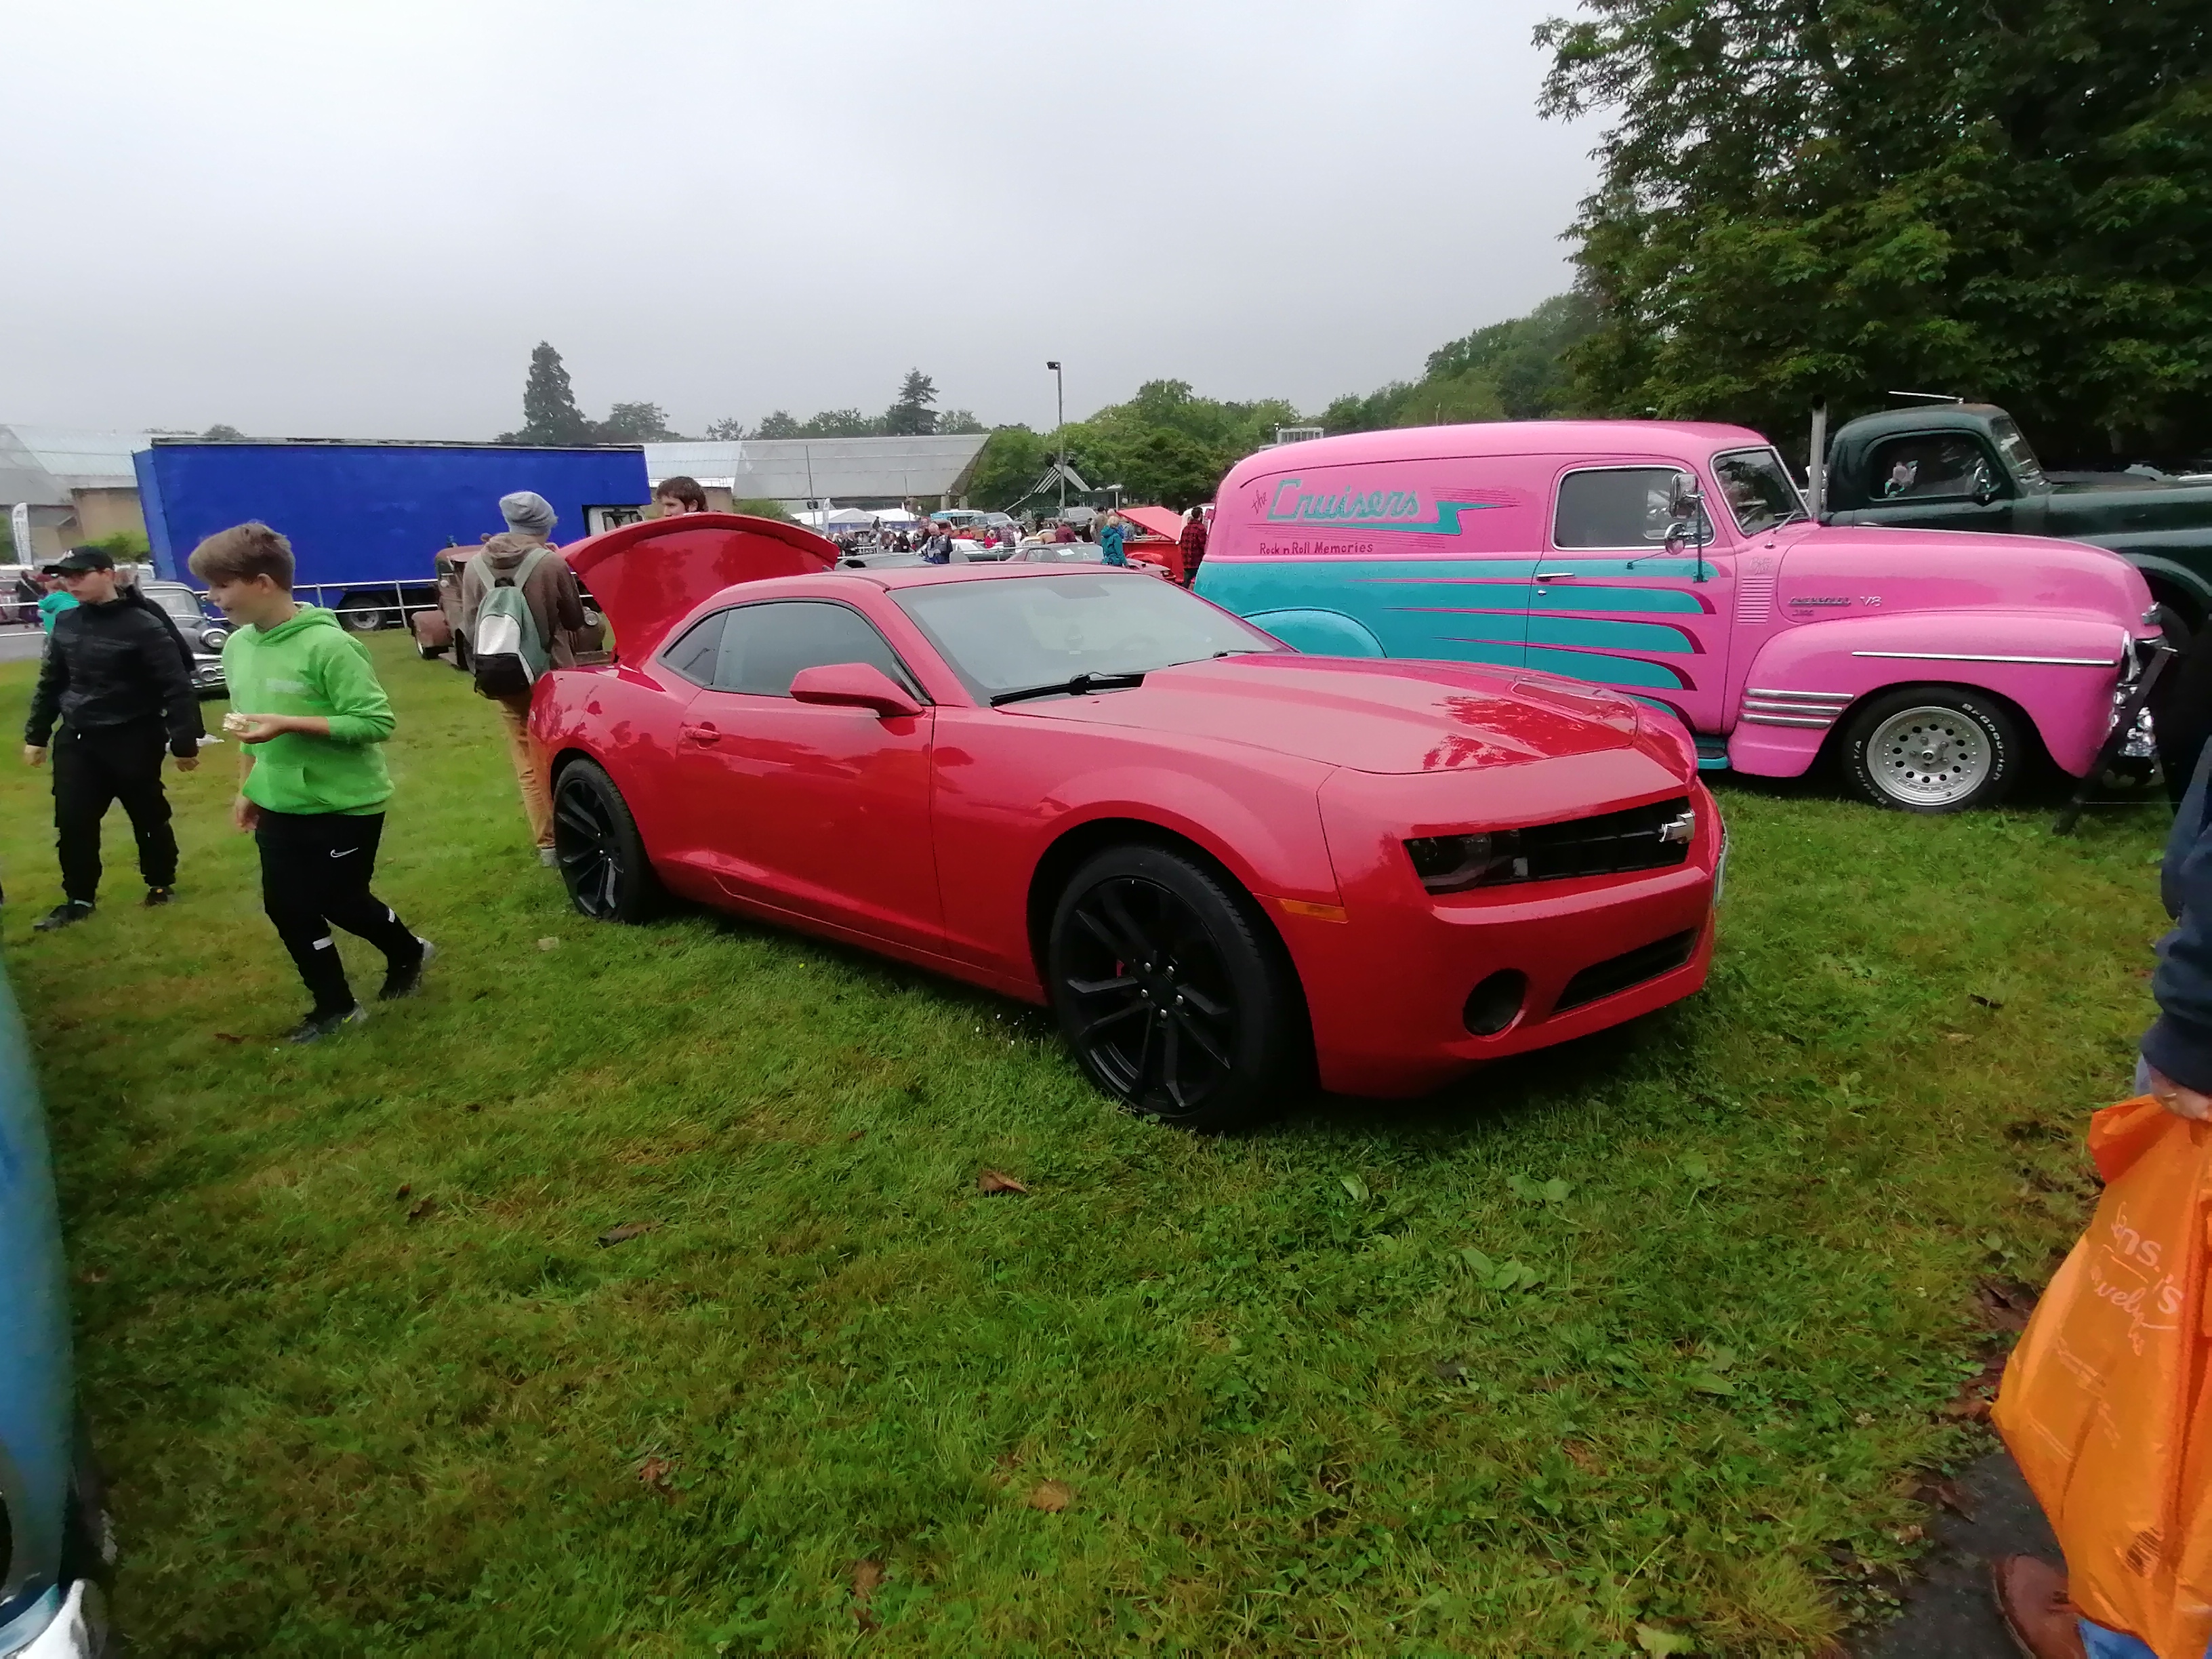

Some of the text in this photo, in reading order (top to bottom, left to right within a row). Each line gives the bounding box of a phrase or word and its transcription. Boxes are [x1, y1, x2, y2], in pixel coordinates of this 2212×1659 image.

[1252, 478, 1420, 521] the Cruisers
[1260, 543, 1280, 554] Rock
[1292, 542, 1310, 554] Roll
[1314, 541, 1373, 554] Memories
[1860, 596, 1882, 607] V8
